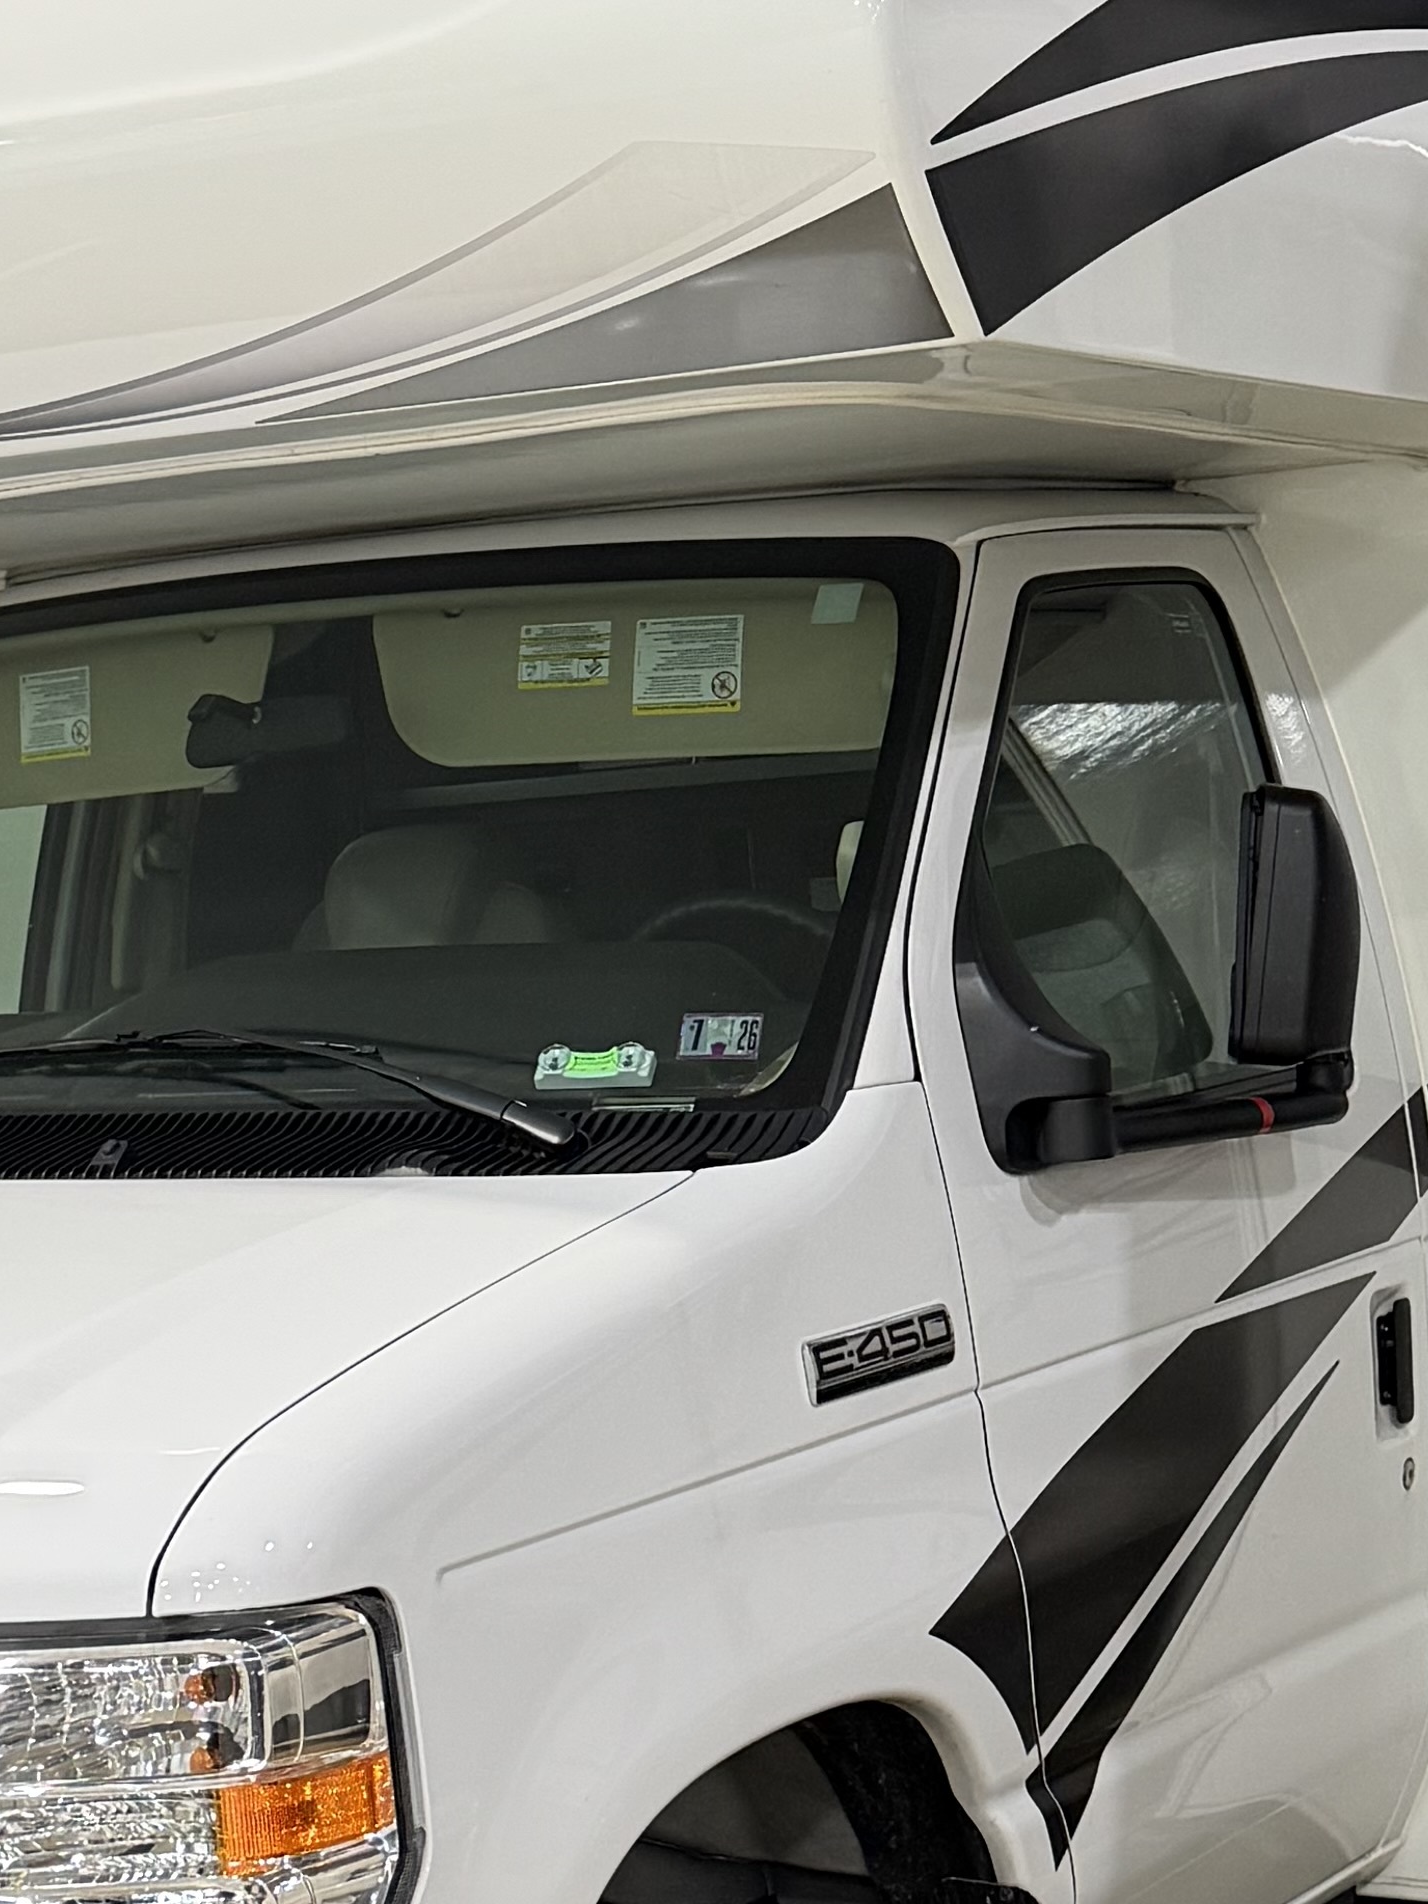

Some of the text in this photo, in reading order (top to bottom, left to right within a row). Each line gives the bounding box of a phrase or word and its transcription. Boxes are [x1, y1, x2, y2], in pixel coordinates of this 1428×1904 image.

[690, 1019, 760, 1052] 7 26
[815, 1306, 953, 1381] E-450
